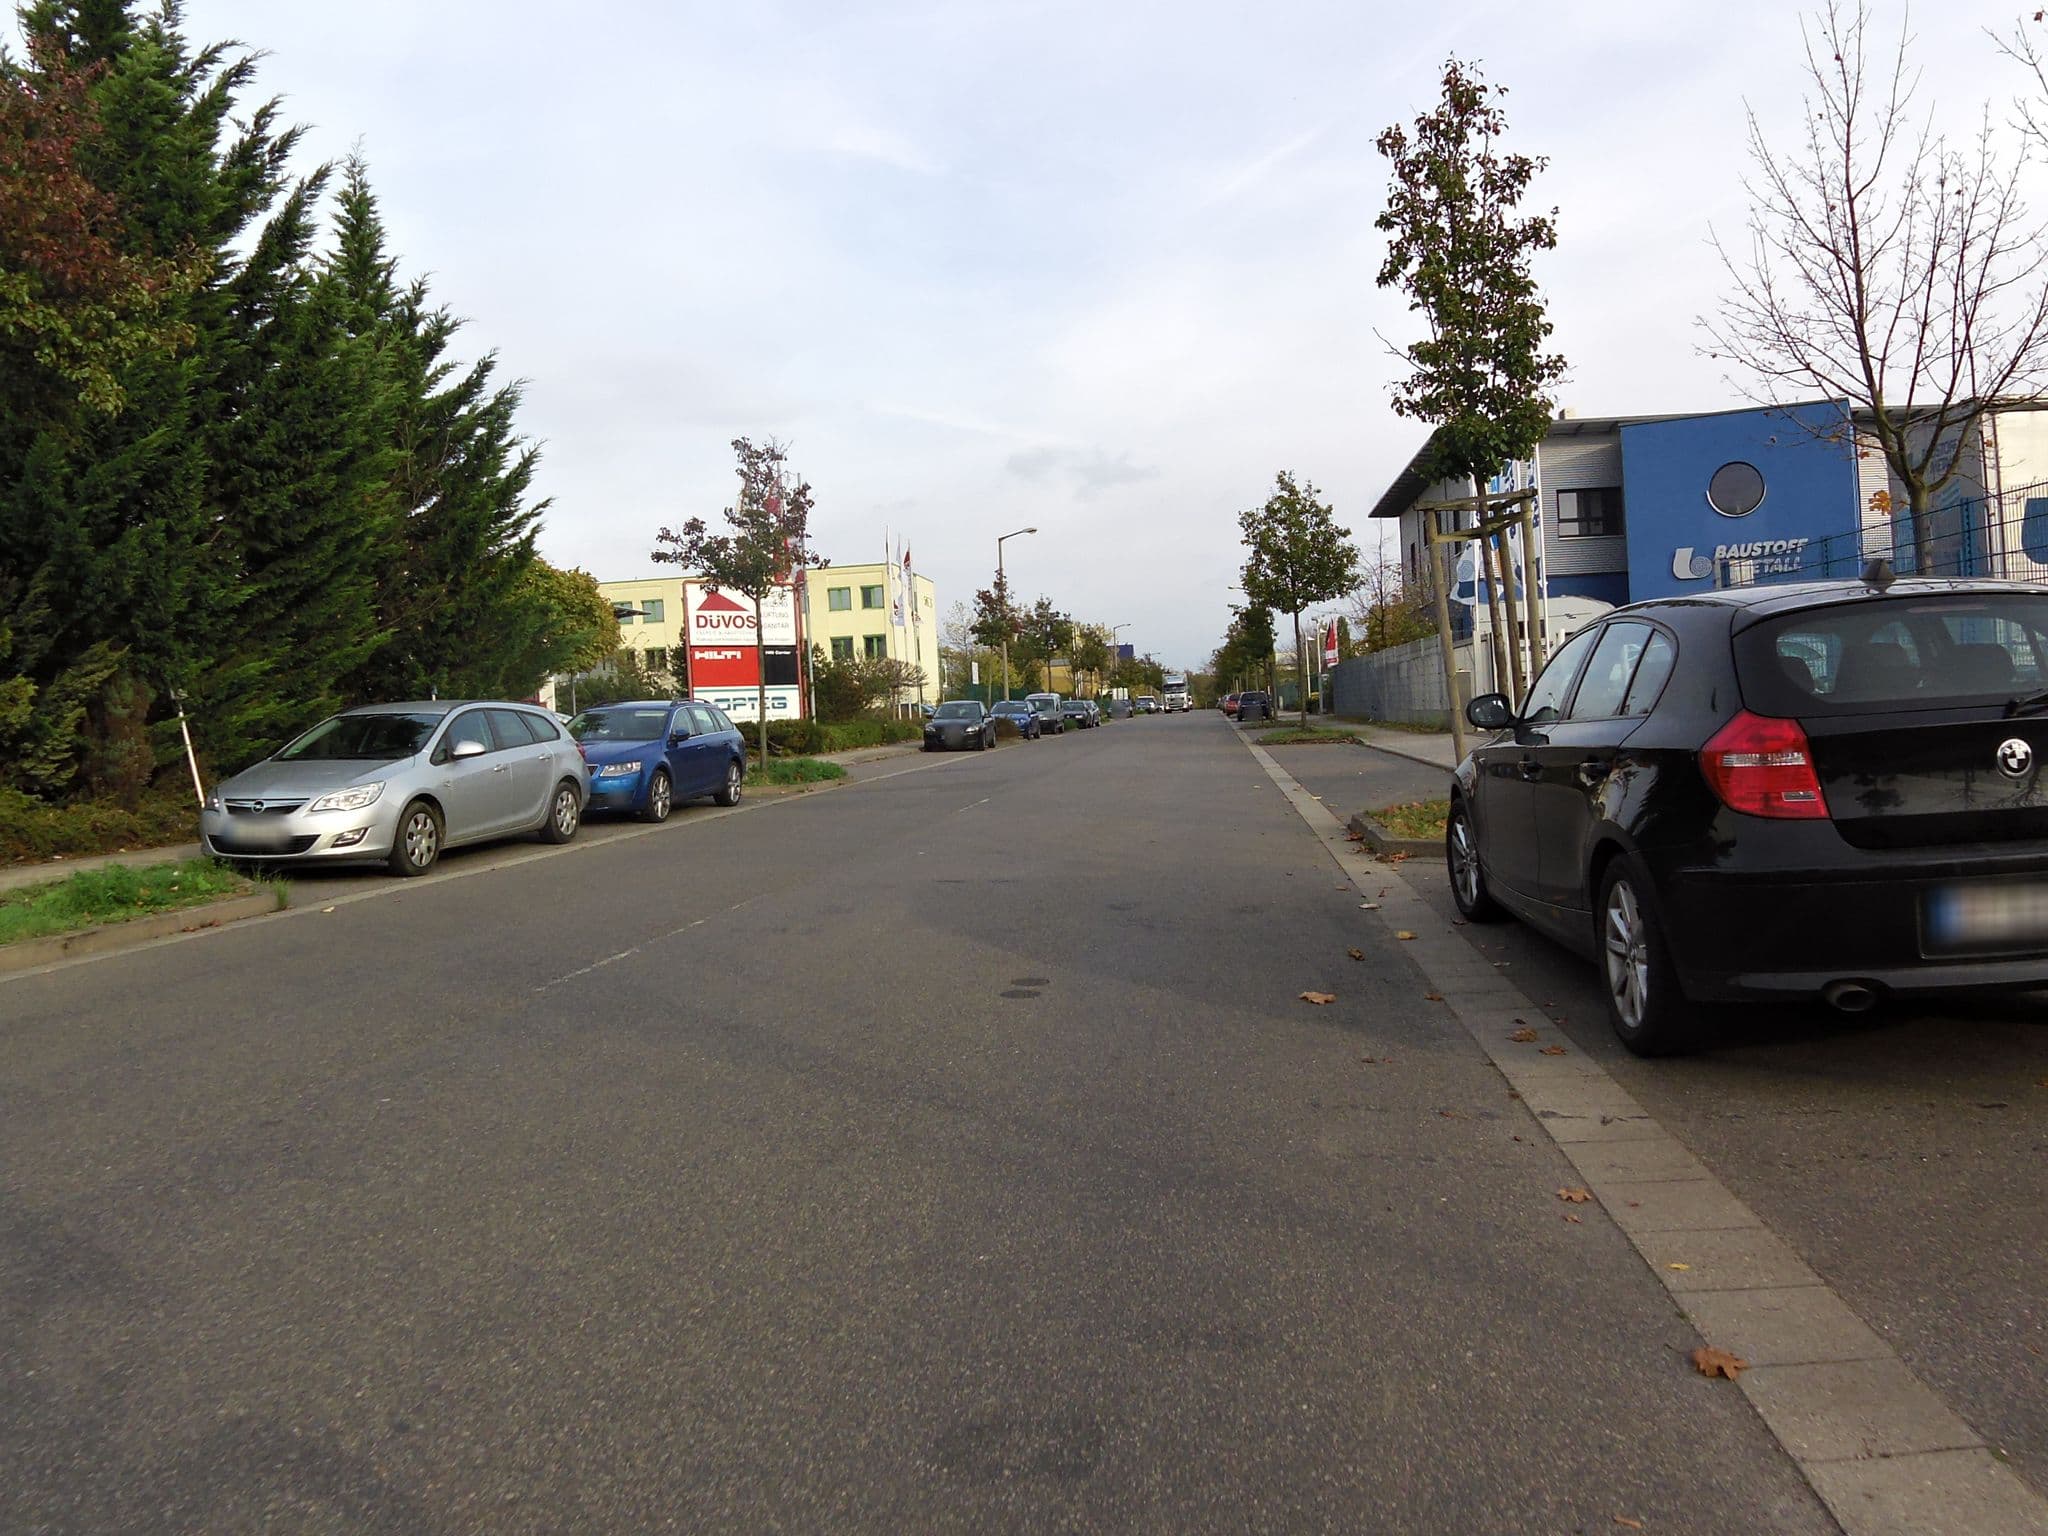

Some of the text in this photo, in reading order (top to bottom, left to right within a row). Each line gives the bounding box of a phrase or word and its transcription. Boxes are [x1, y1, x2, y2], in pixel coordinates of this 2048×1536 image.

[1714, 538, 1809, 560] BAUSTOFF
[1752, 556, 1803, 575] ETALL
[694, 650, 742, 660] HILTI
